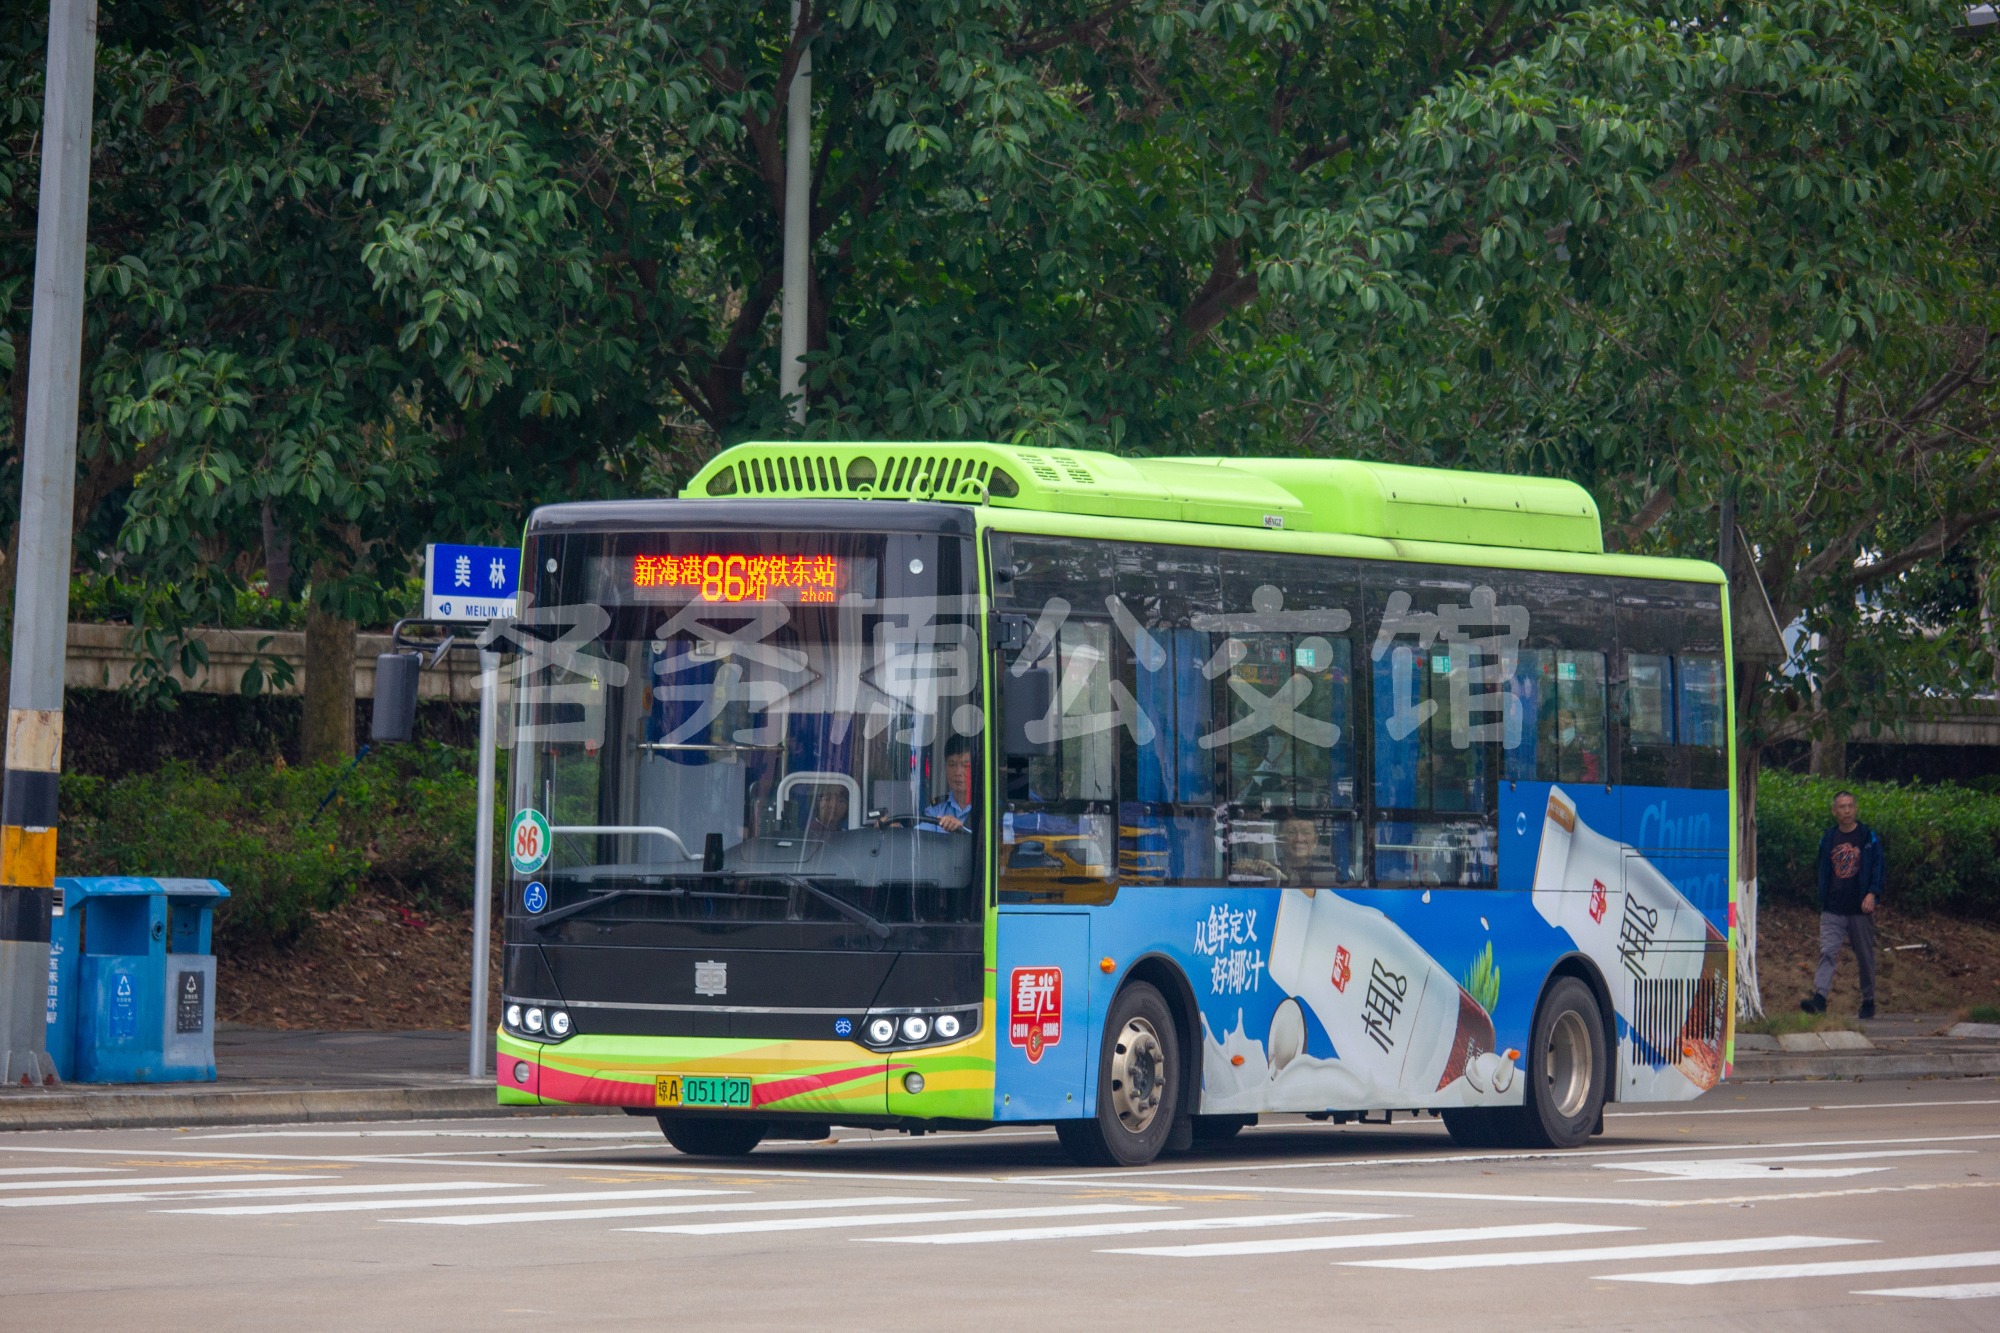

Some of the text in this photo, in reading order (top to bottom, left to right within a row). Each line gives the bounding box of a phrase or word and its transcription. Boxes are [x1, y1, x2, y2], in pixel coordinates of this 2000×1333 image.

[465, 605, 498, 617] MEILIN
[501, 606, 514, 617] LU
[516, 826, 538, 857] 86
[1192, 903, 1258, 956] 从鲜定义
[1210, 949, 1265, 995] 好椰汁
[1017, 972, 1055, 1023] 春光
[1012, 1023, 1029, 1038] CHUN
